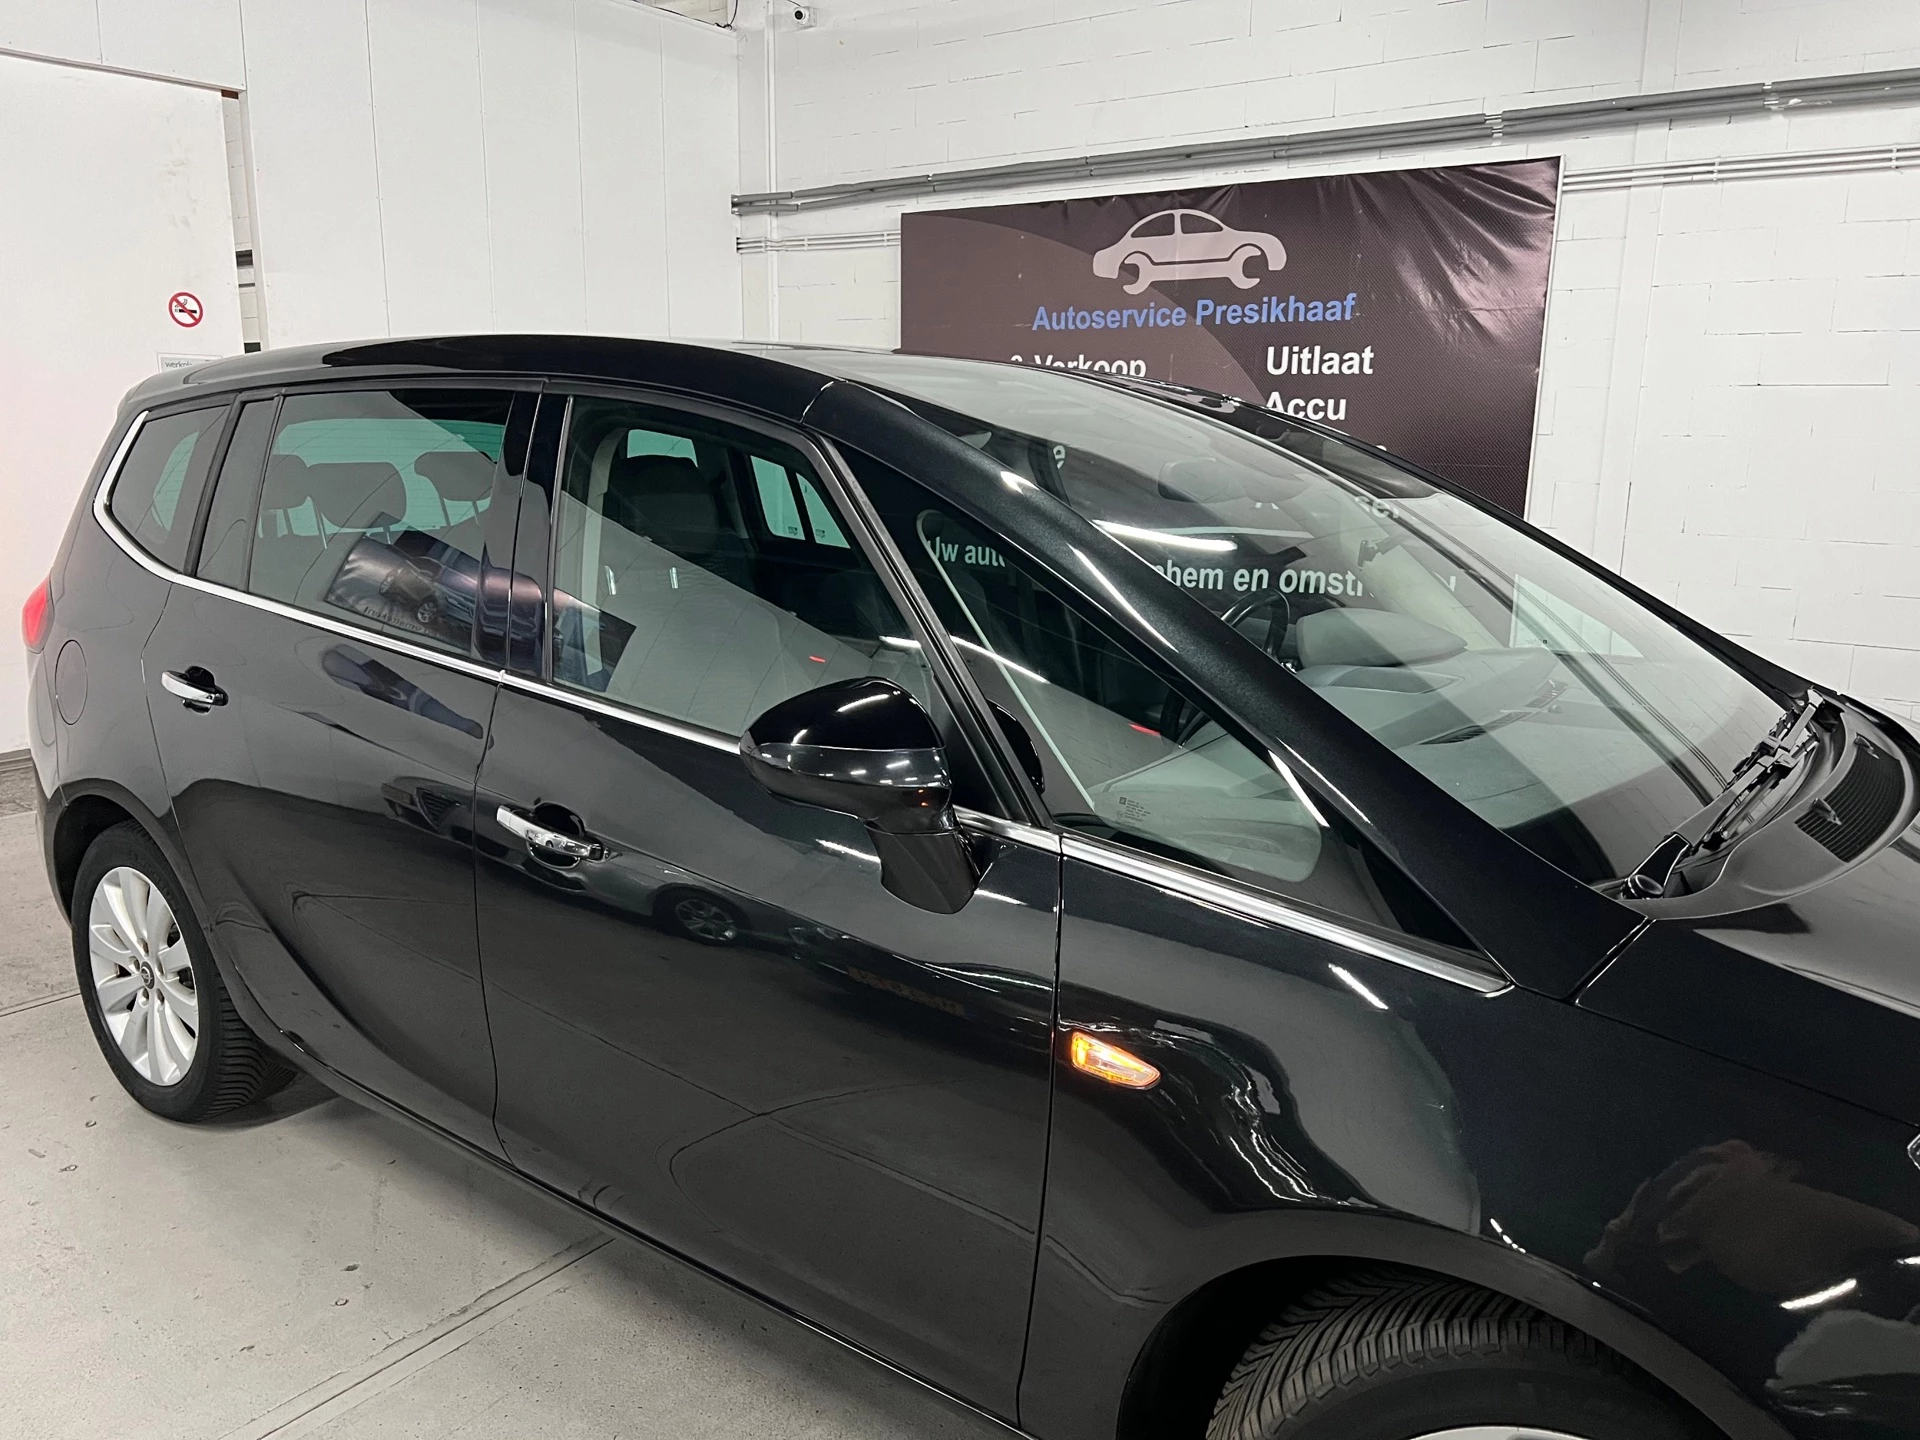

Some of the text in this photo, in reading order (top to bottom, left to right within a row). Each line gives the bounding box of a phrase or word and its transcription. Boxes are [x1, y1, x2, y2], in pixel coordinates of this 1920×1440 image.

[1031, 292, 1357, 331] Autoservice Presikhaaf
[1266, 345, 1375, 376] Uitlaat
[1265, 391, 1347, 421] Accu
[964, 545, 1006, 568] aut
[1233, 568, 1270, 593] en
